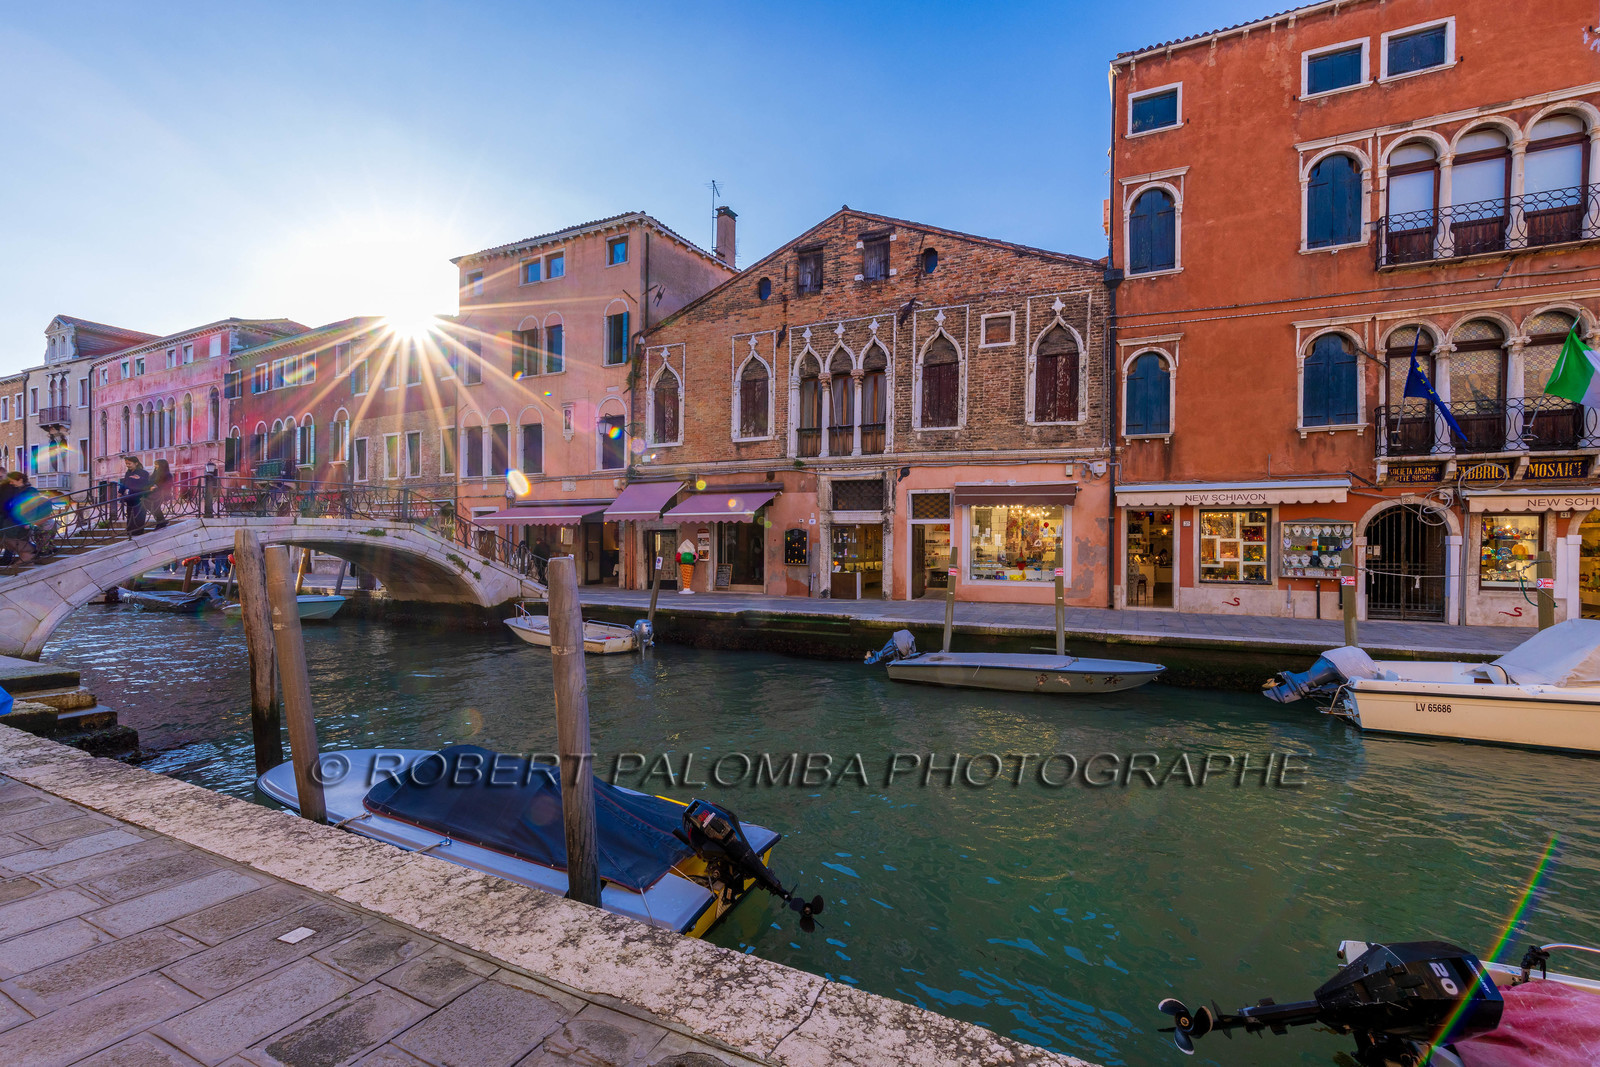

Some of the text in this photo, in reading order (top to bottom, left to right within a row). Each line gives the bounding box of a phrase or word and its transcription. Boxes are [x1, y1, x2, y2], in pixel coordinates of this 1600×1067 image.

[1454, 464, 1511, 480] FABBRICA
[1185, 493, 1266, 502] NEW SCHIAVON
[1527, 498, 1560, 507] NEW
[1416, 703, 1452, 713] LV 65686
[1428, 962, 1458, 995] 20
